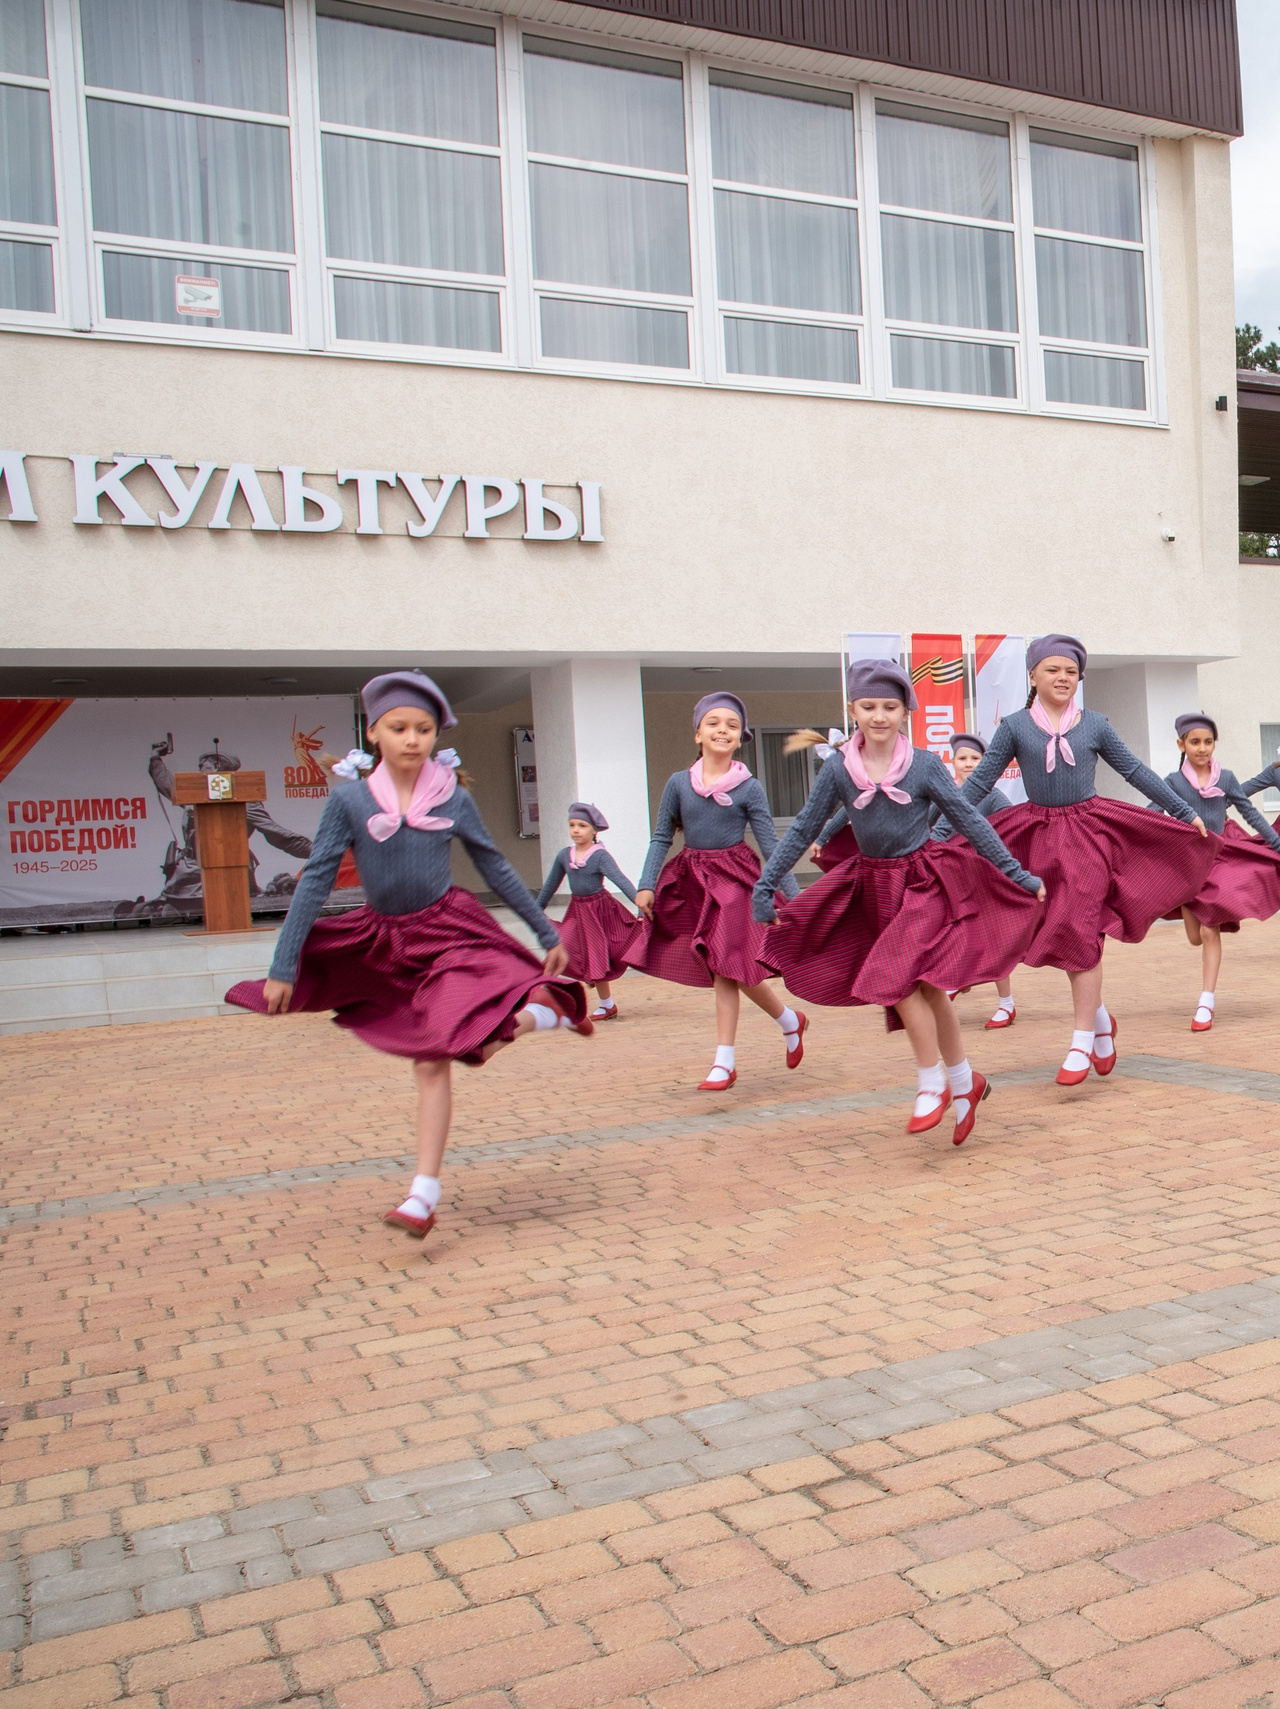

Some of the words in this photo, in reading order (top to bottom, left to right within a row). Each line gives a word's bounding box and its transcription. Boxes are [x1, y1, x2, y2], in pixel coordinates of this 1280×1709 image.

[69, 454, 604, 542] КУЛЬТУРЫ
[284, 765, 308, 785] 80
[285, 787, 329, 799] ПОБЕДА!
[8, 797, 147, 826] ГОРДИМСЯ
[10, 824, 137, 855] ПОБЕДОЙ!
